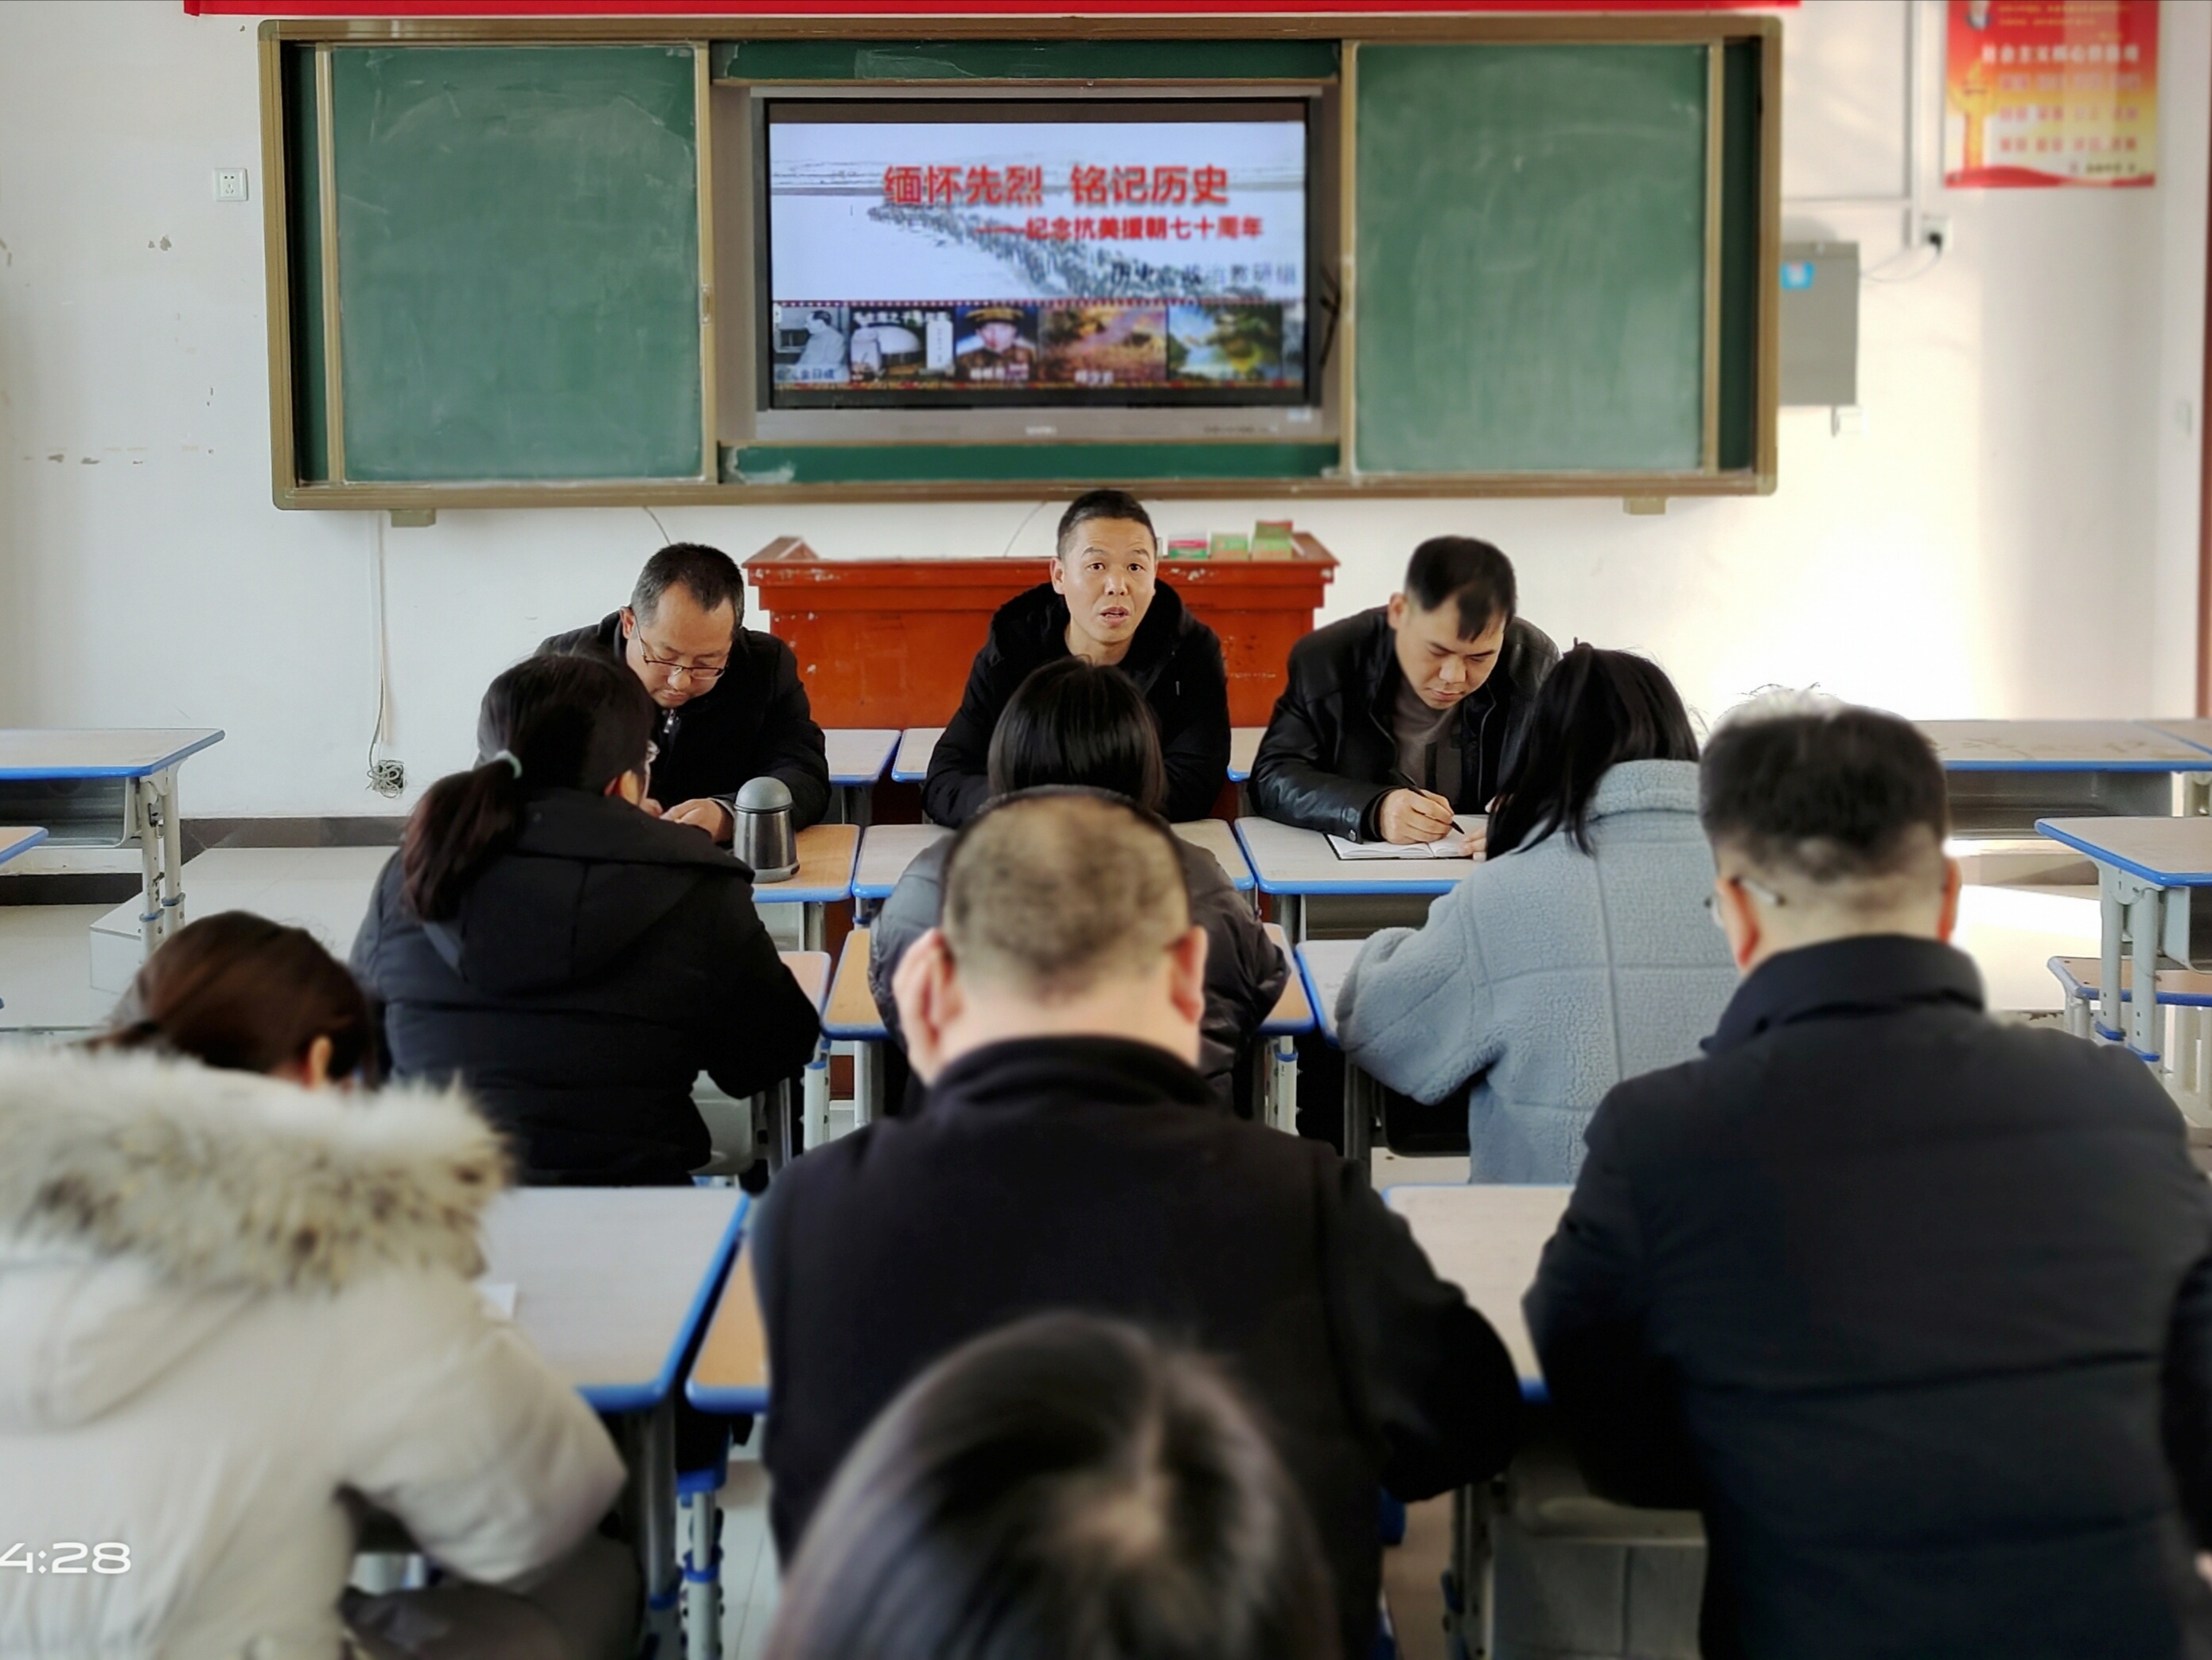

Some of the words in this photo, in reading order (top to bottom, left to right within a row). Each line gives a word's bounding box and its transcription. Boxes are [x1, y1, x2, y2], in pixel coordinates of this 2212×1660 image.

[883, 166, 1043, 206] 缅怀先烈
[1070, 166, 1229, 205] 铭记历史
